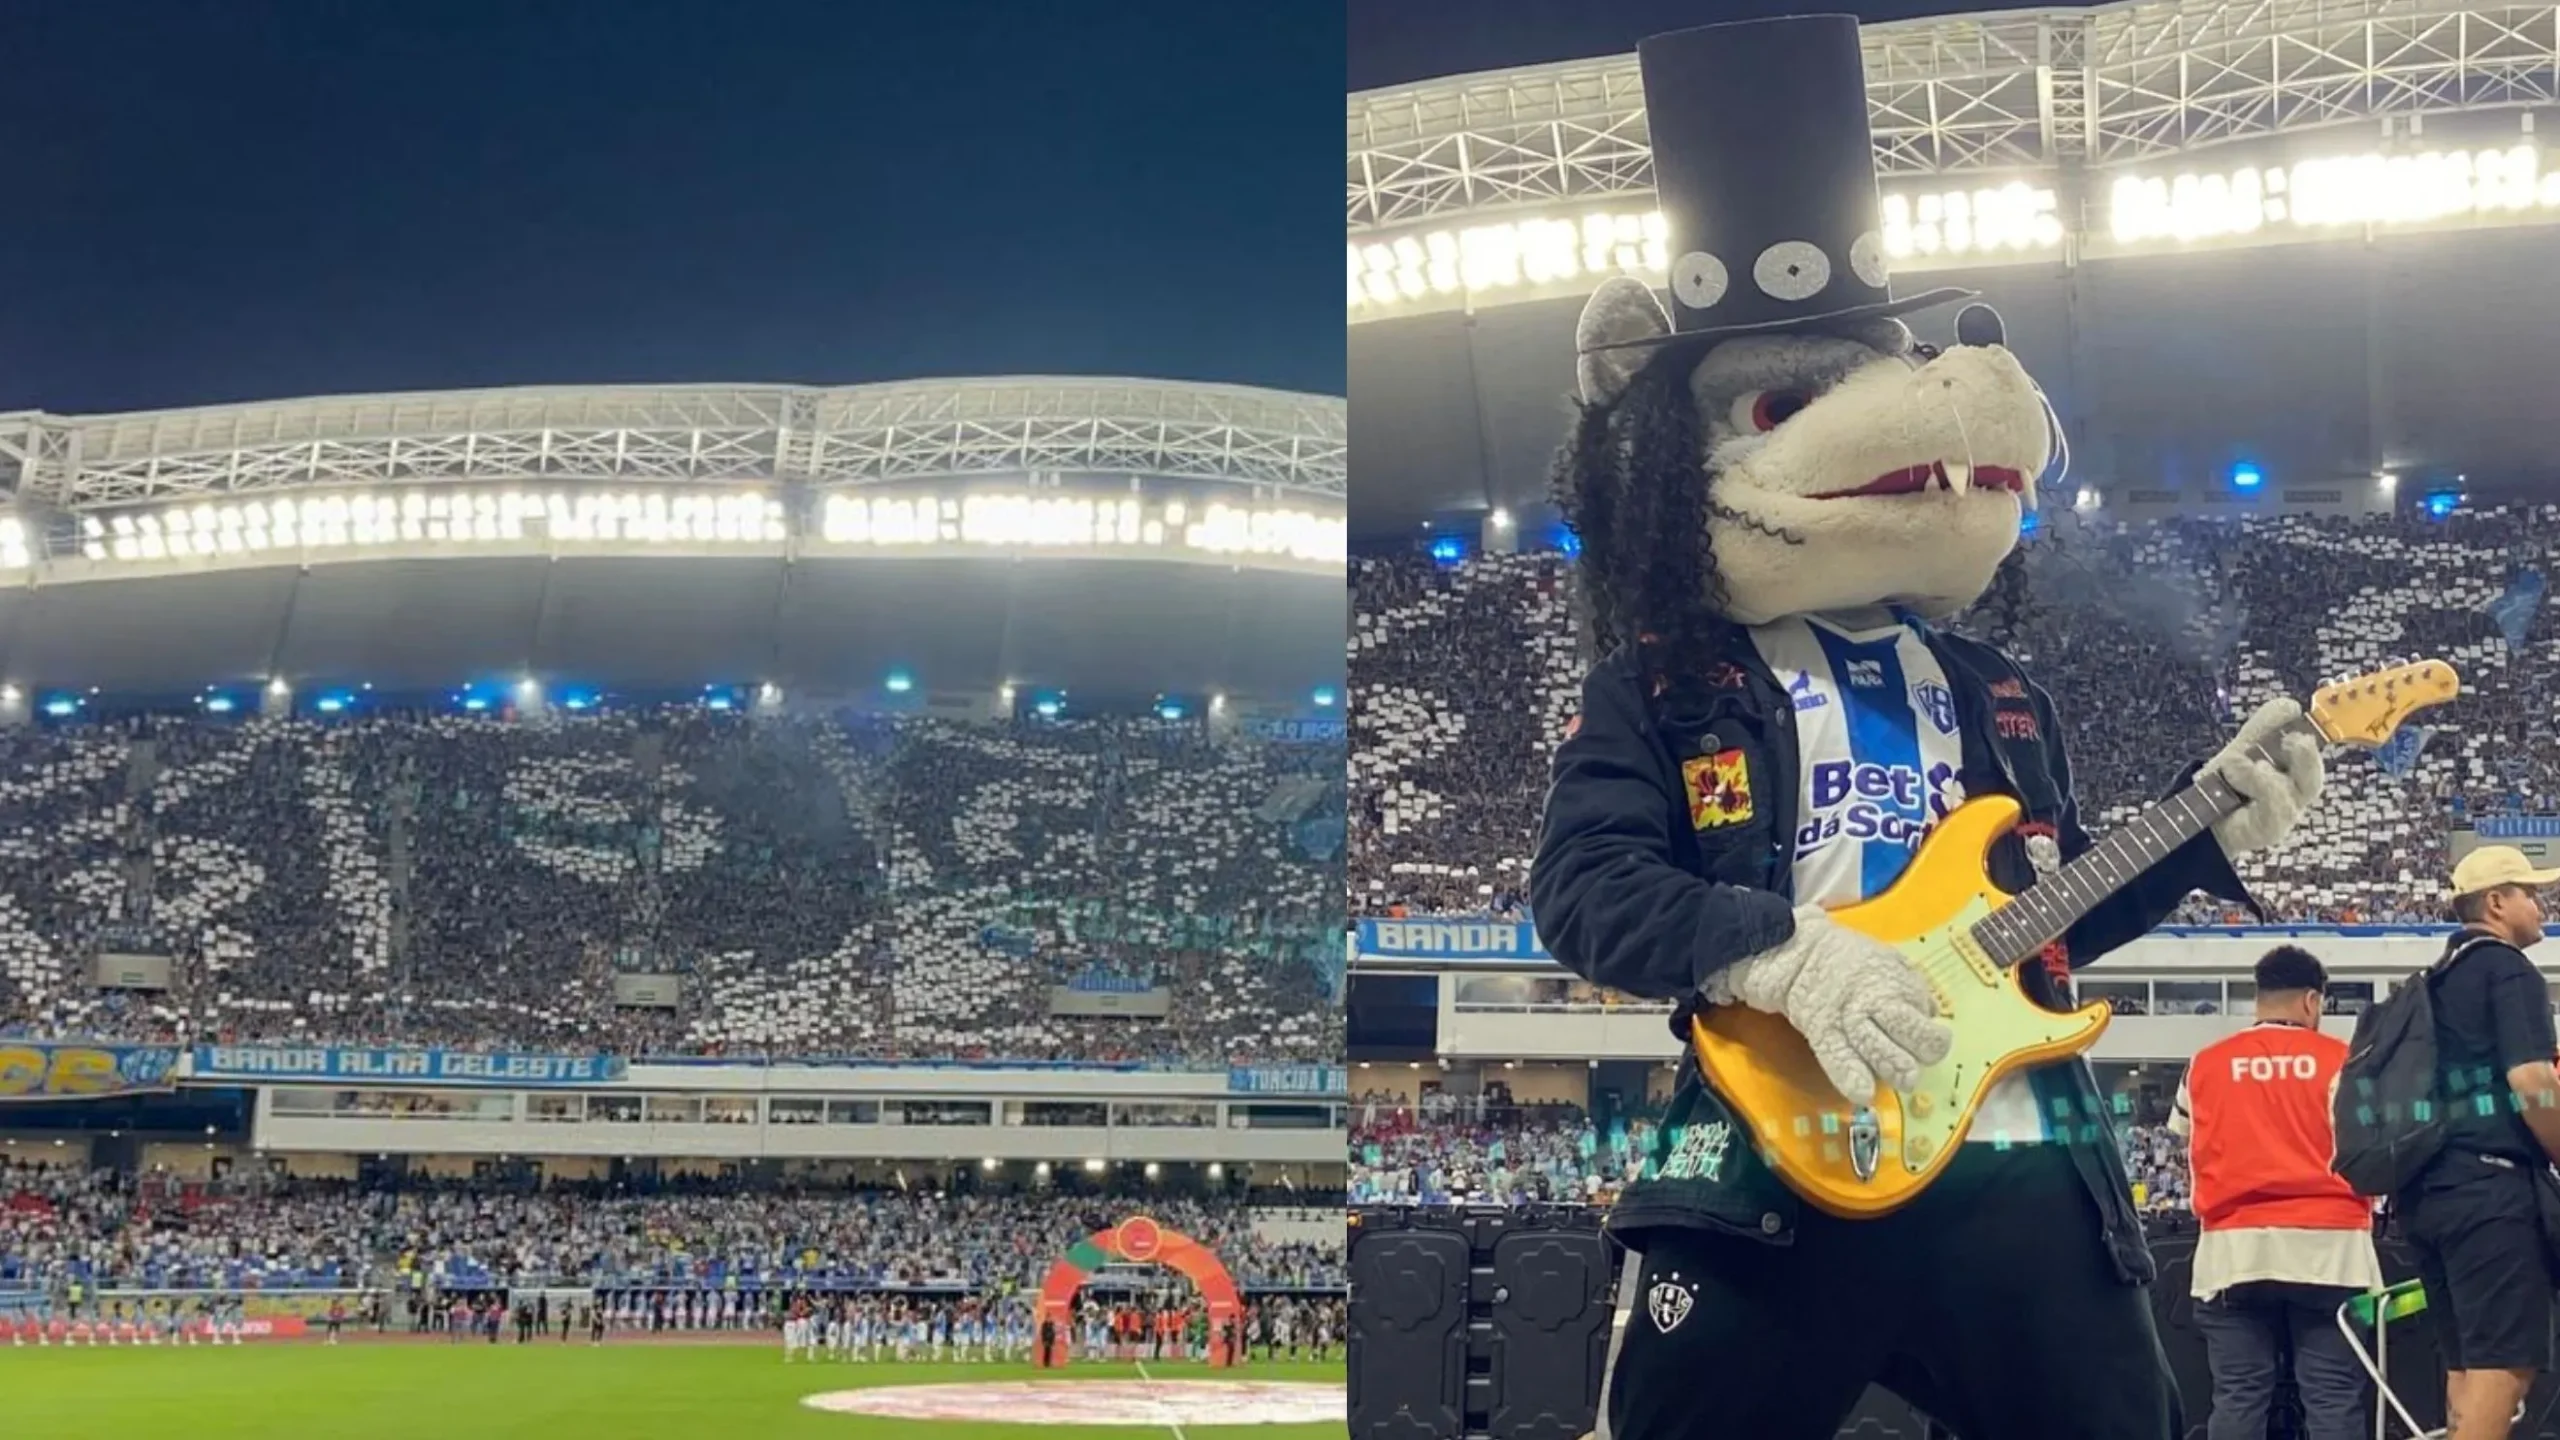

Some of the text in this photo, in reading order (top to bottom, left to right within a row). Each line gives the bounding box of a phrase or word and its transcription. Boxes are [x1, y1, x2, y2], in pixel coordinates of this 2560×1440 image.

[1812, 758, 1920, 809] Bet
[1798, 811, 1840, 847] dá
[1376, 922, 1518, 952] BANDA
[212, 1047, 593, 1078] BANDA ALMA CELESTE
[2230, 1053, 2317, 1083] FOTO
